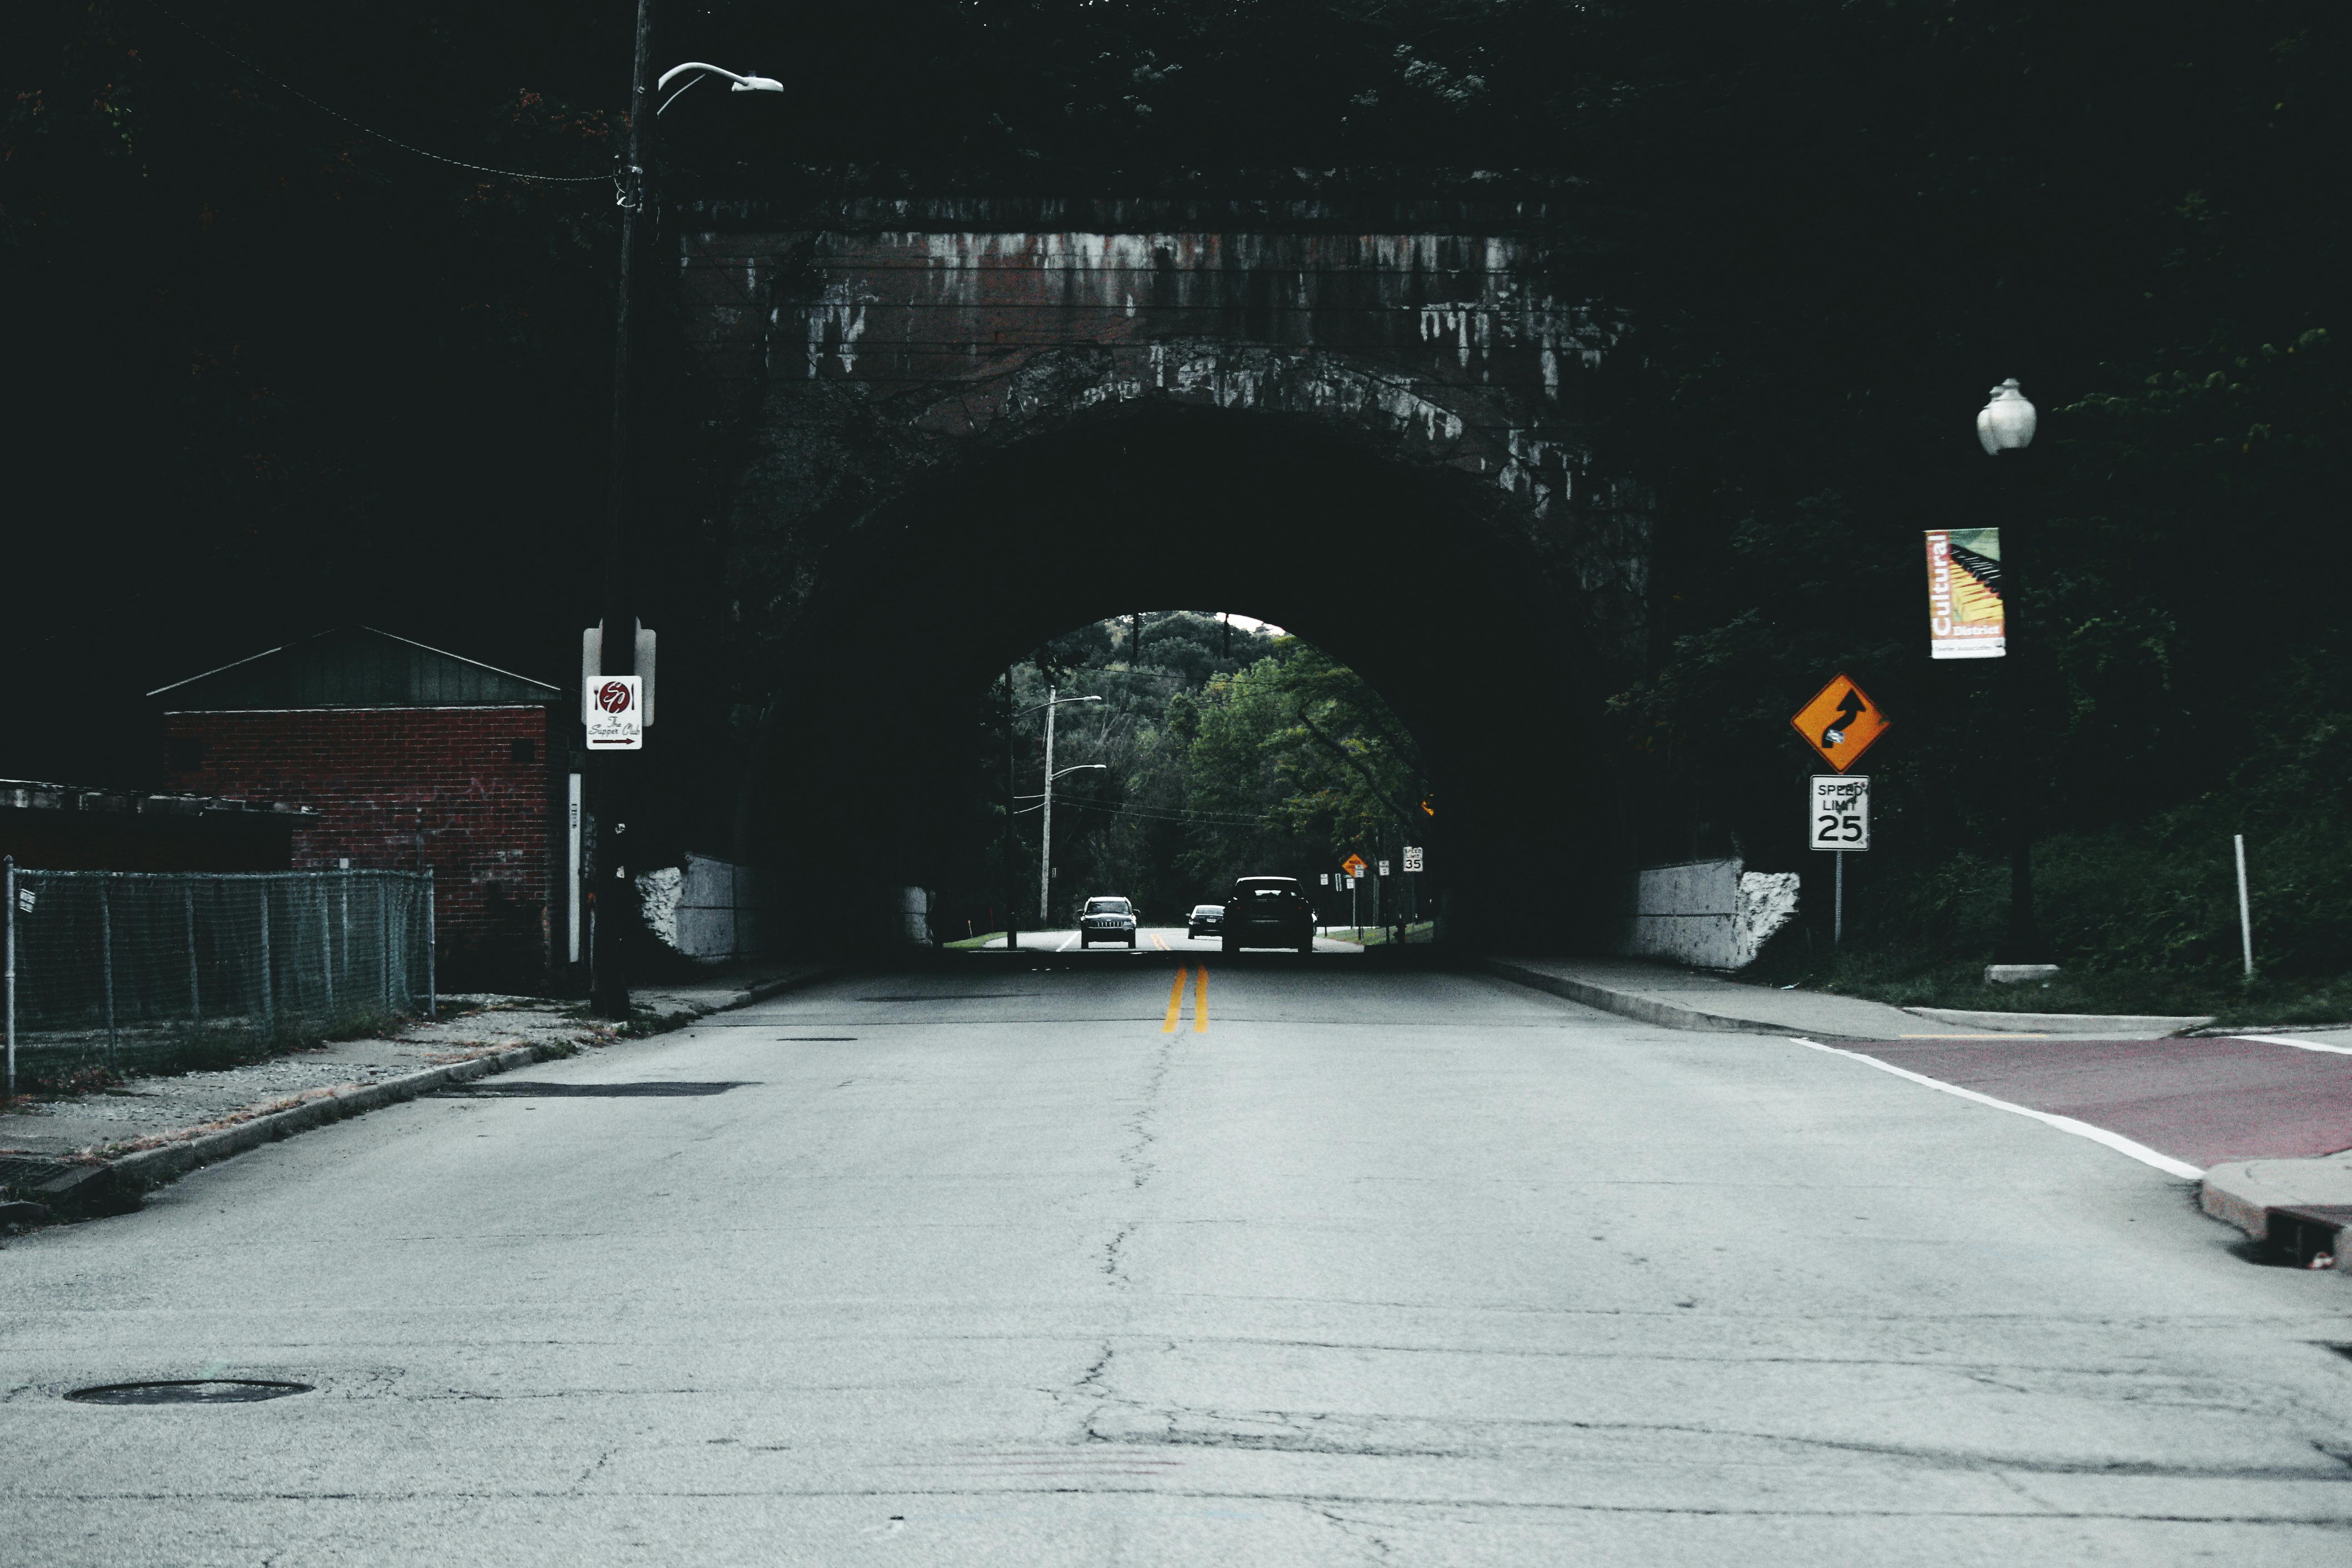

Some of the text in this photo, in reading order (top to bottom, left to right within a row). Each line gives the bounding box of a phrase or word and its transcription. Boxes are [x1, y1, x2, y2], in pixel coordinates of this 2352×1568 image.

[1928, 534, 1951, 636] Cultural
[607, 716, 622, 728] The
[588, 723, 641, 737] Supper Club
[1818, 785, 1862, 796] SPEED
[1818, 815, 1862, 842] 25
[1406, 859, 1421, 869] 35
